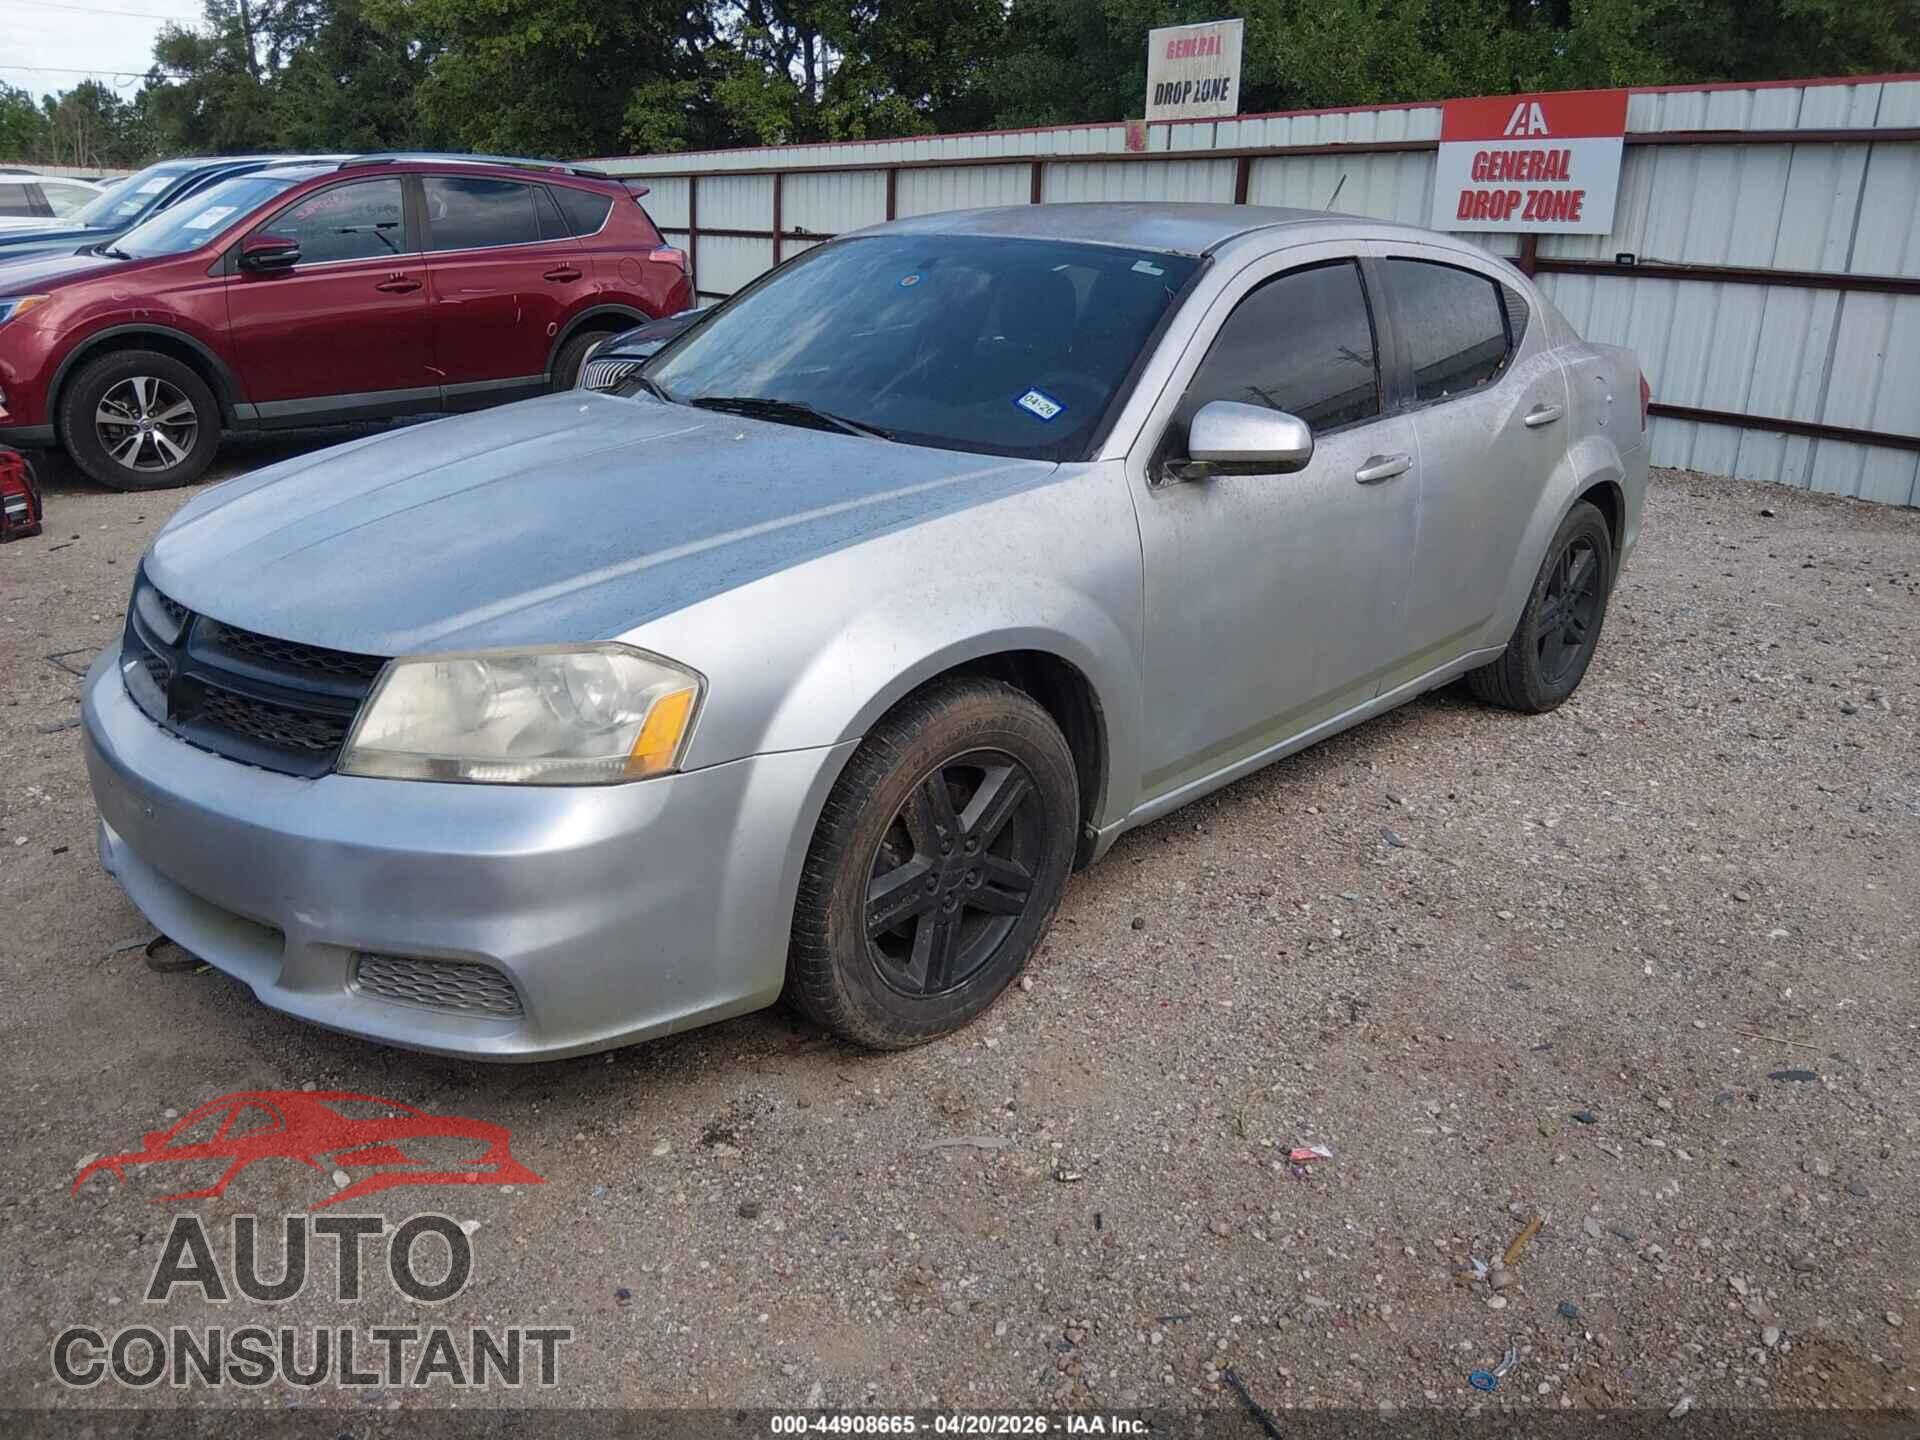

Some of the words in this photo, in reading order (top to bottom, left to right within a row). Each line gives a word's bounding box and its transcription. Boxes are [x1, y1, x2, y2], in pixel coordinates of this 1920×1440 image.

[1167, 36, 1223, 59] GENERAL
[1153, 81, 1192, 105] DROP
[1193, 78, 1230, 103] ZONE
[1471, 150, 1571, 182] GENERAL
[1457, 190, 1521, 221] DROP
[1521, 190, 1585, 221] ZONE
